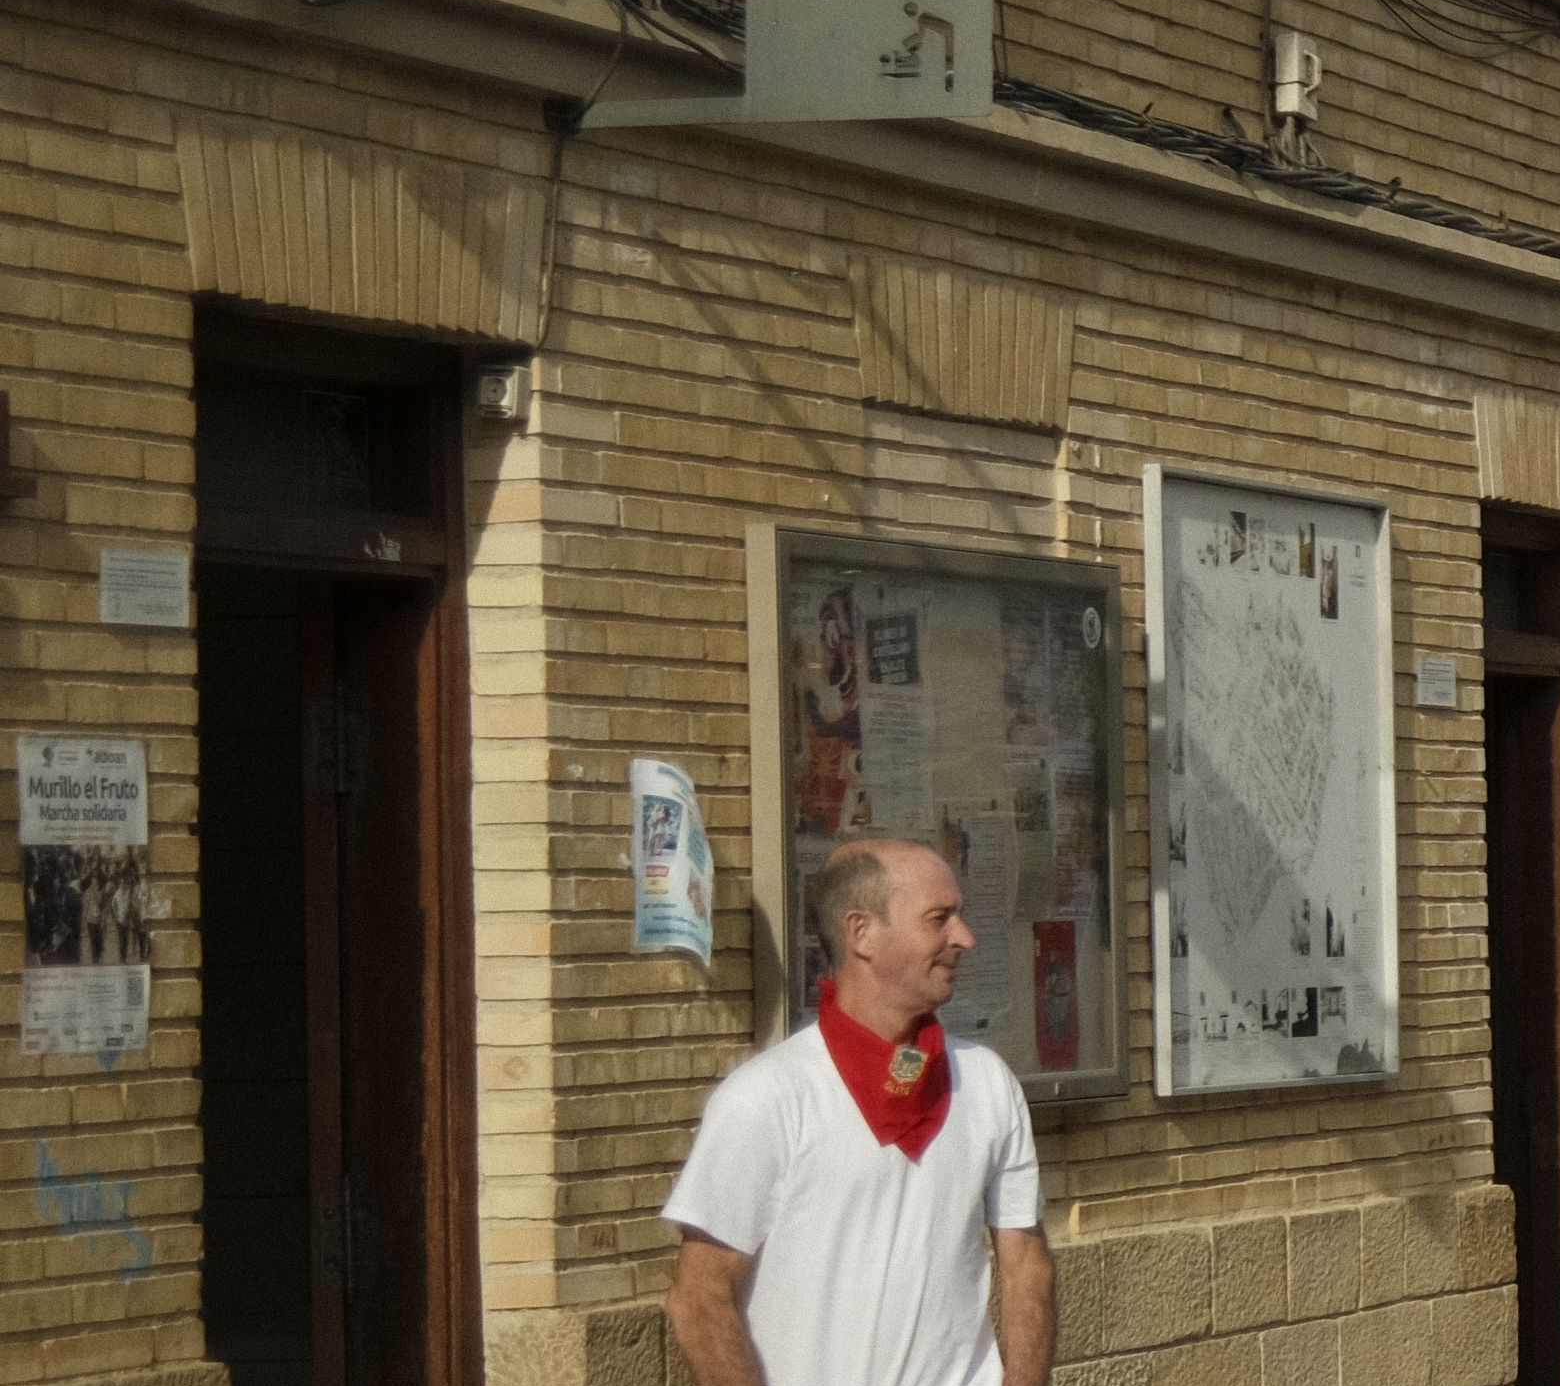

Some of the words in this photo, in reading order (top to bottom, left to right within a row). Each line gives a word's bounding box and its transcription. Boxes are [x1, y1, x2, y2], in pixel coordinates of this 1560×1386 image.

[29, 775, 81, 799] Murillo
[84, 775, 97, 799] el
[100, 777, 139, 800] Fruto
[40, 804, 80, 821] Marcha
[82, 803, 127, 821] solidaria
